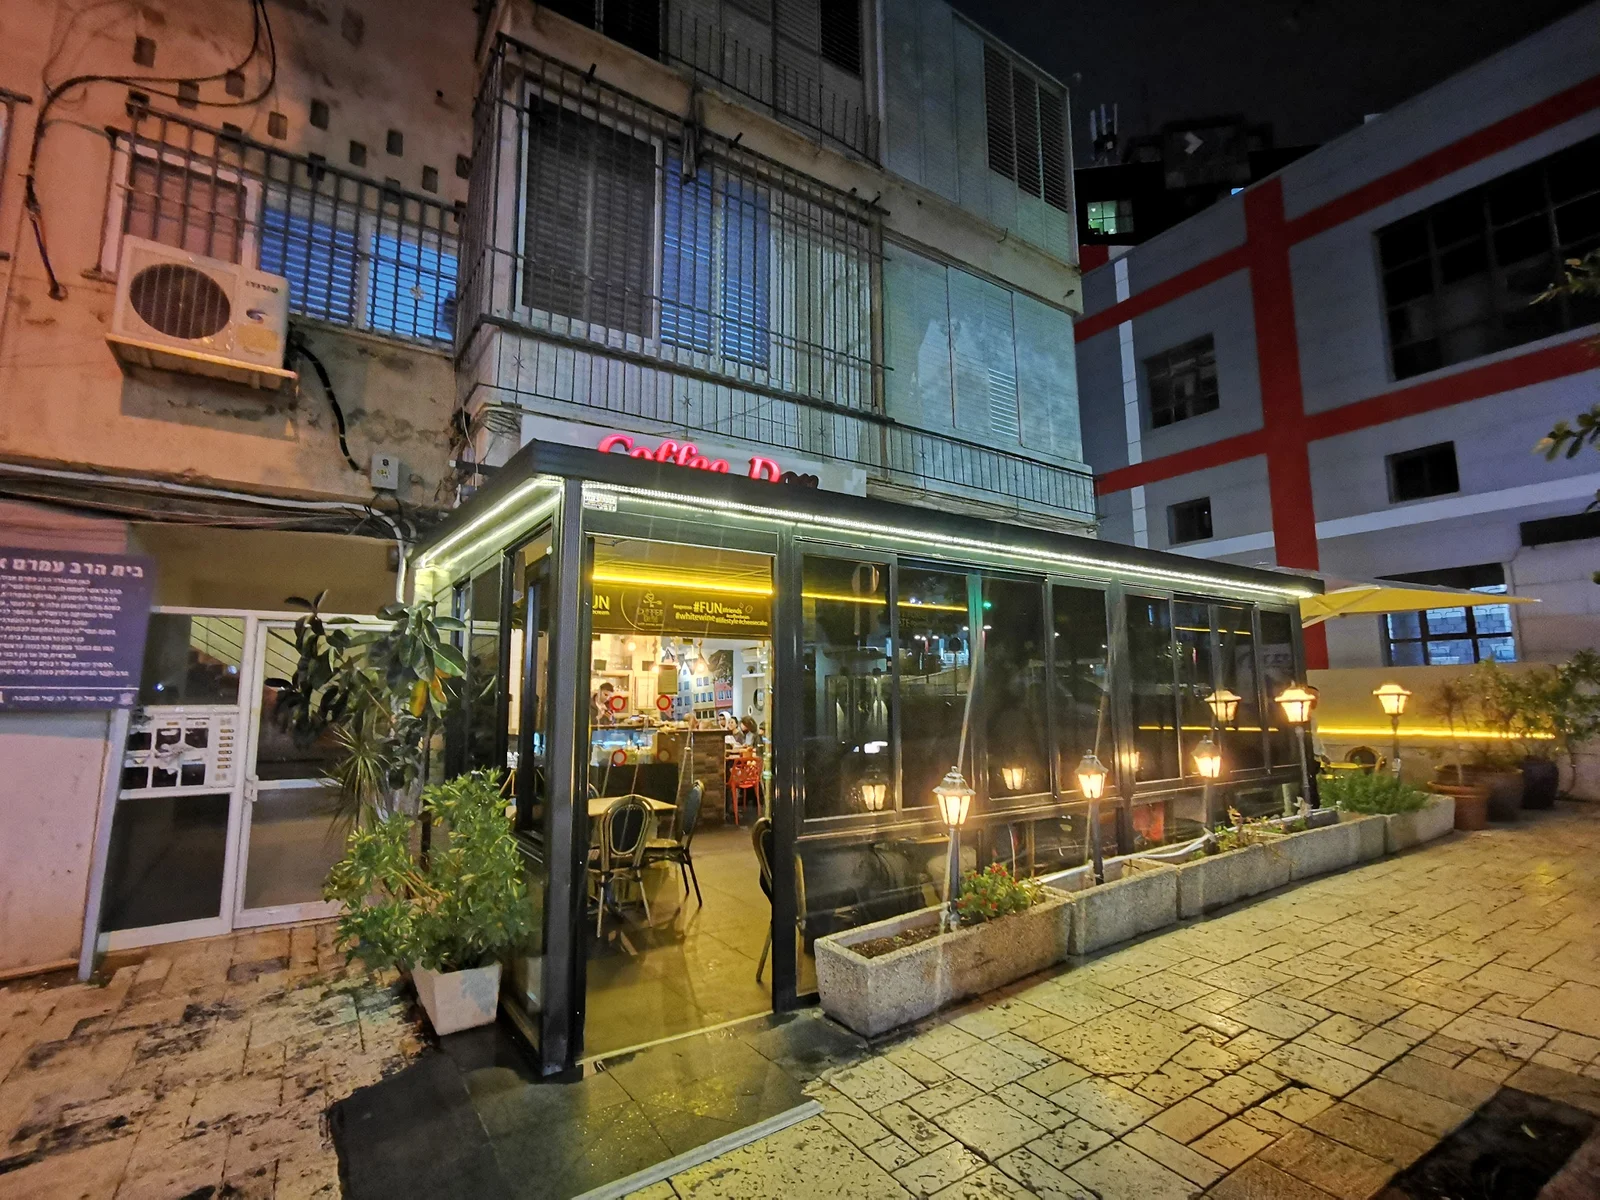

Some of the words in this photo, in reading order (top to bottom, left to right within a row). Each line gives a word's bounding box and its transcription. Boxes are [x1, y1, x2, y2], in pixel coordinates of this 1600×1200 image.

[12, 557, 65, 573] עמרם
[69, 561, 107, 576] הרב
[110, 564, 144, 578] בית
[693, 600, 723, 614] #FUN
[675, 611, 716, 622] #whitewine
